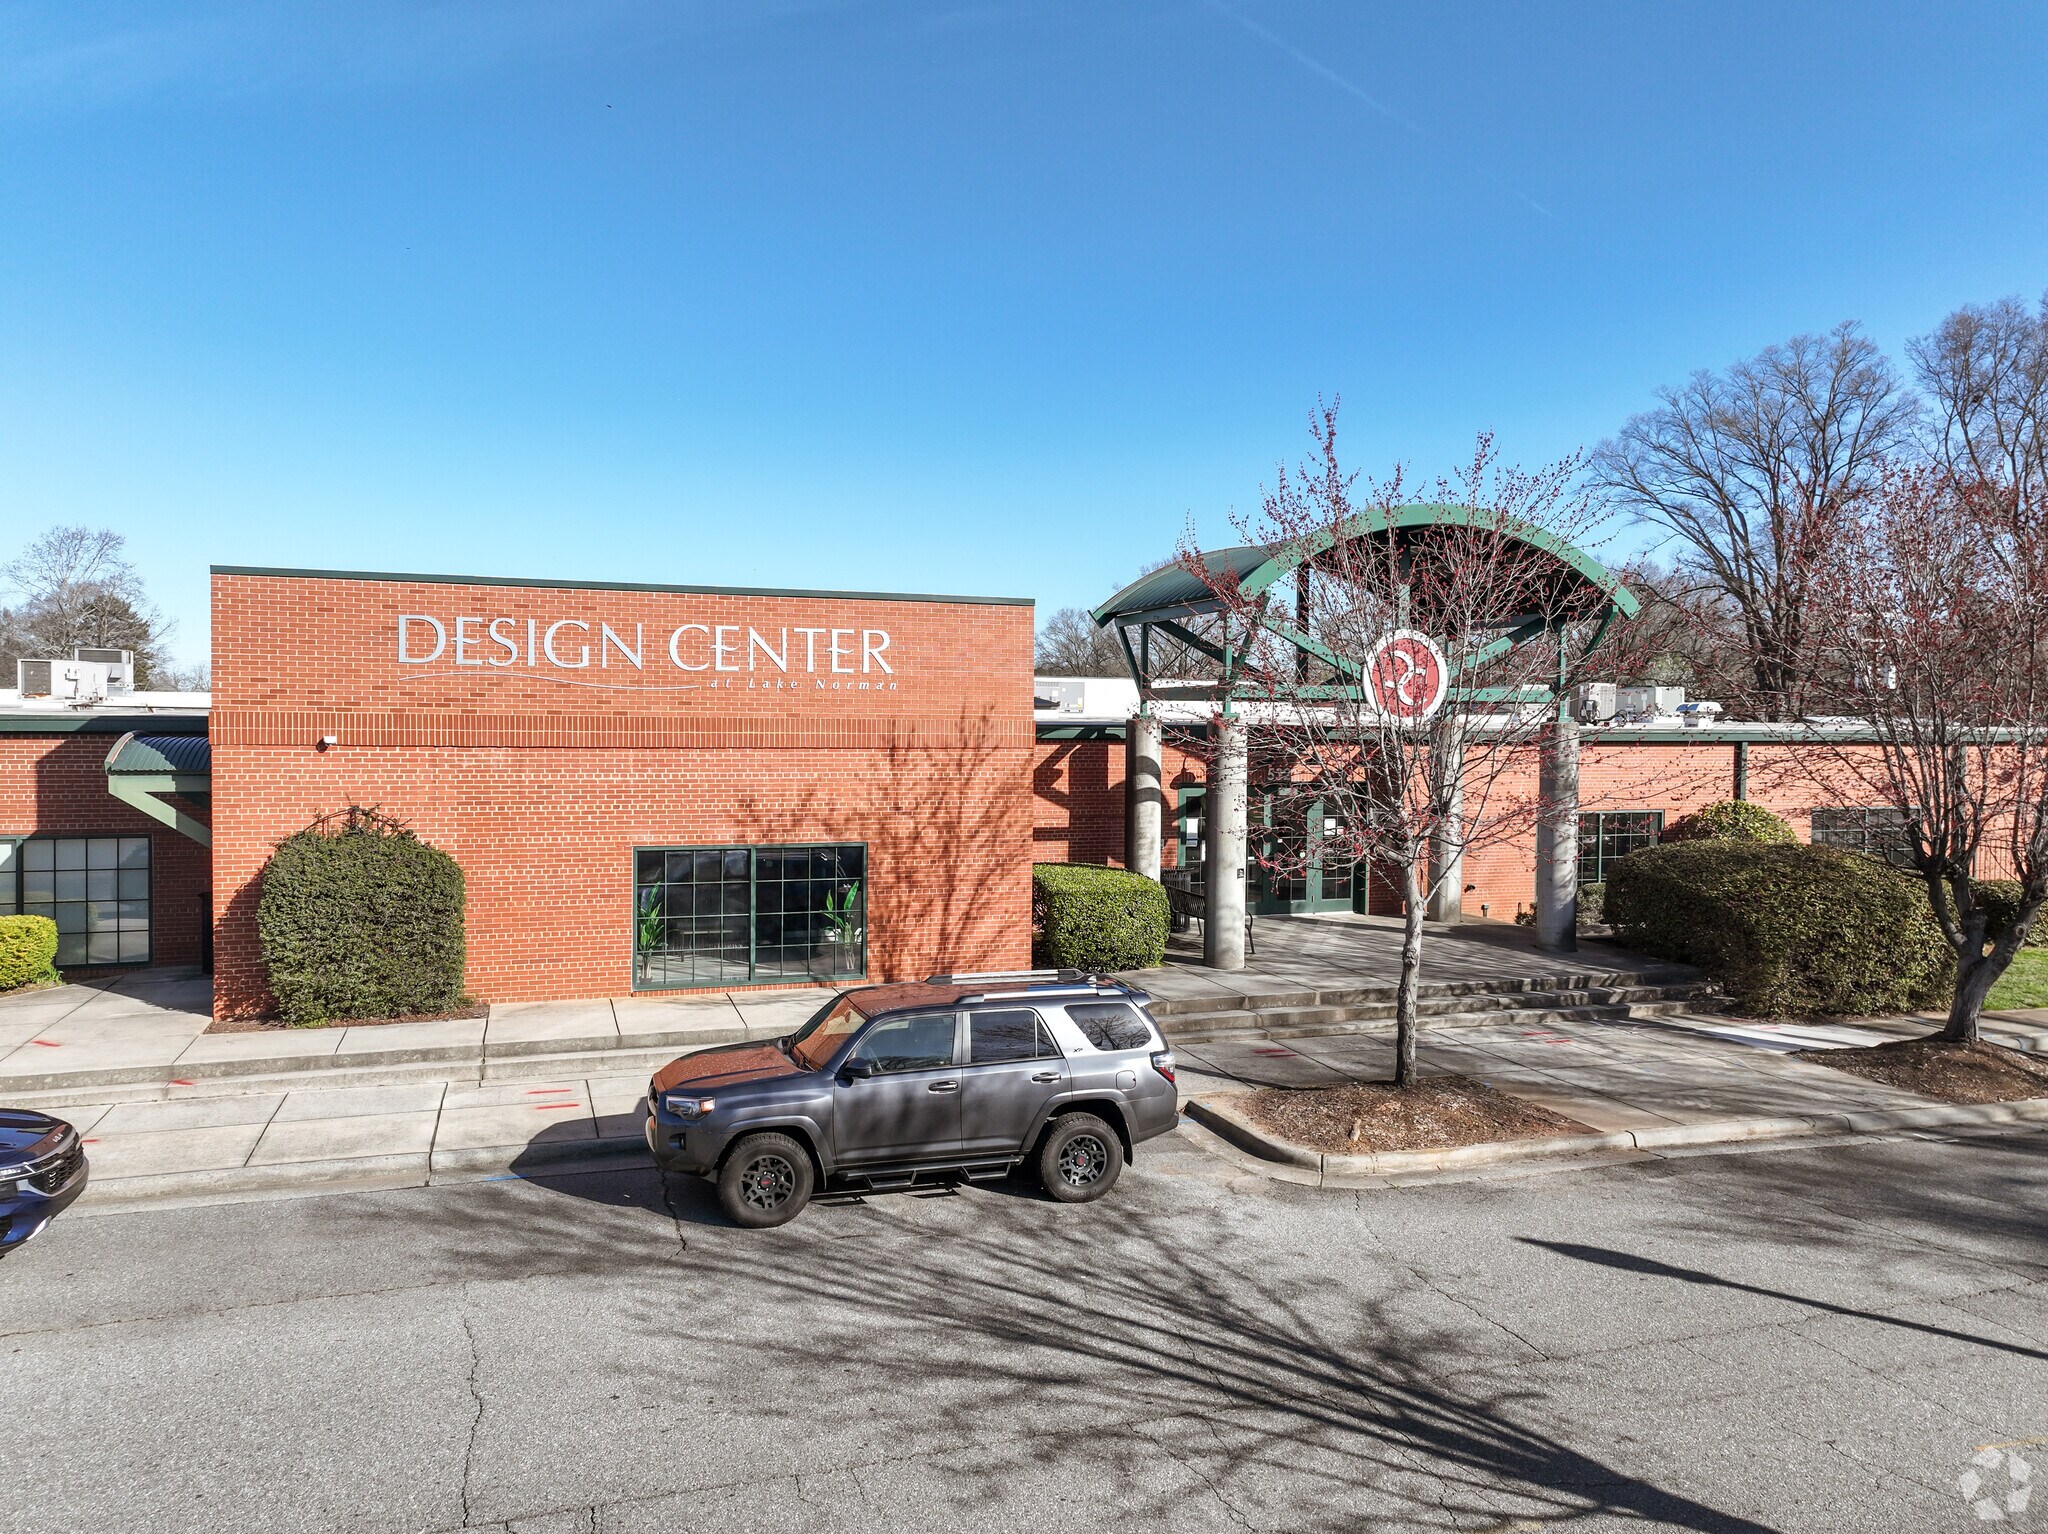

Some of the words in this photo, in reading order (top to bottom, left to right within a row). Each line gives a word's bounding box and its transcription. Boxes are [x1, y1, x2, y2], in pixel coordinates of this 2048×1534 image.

[397, 614, 643, 670] DESIGN
[668, 623, 894, 674] CENTER
[710, 679, 731, 688] at
[749, 678, 798, 689] Lake
[815, 679, 898, 690] Norman
